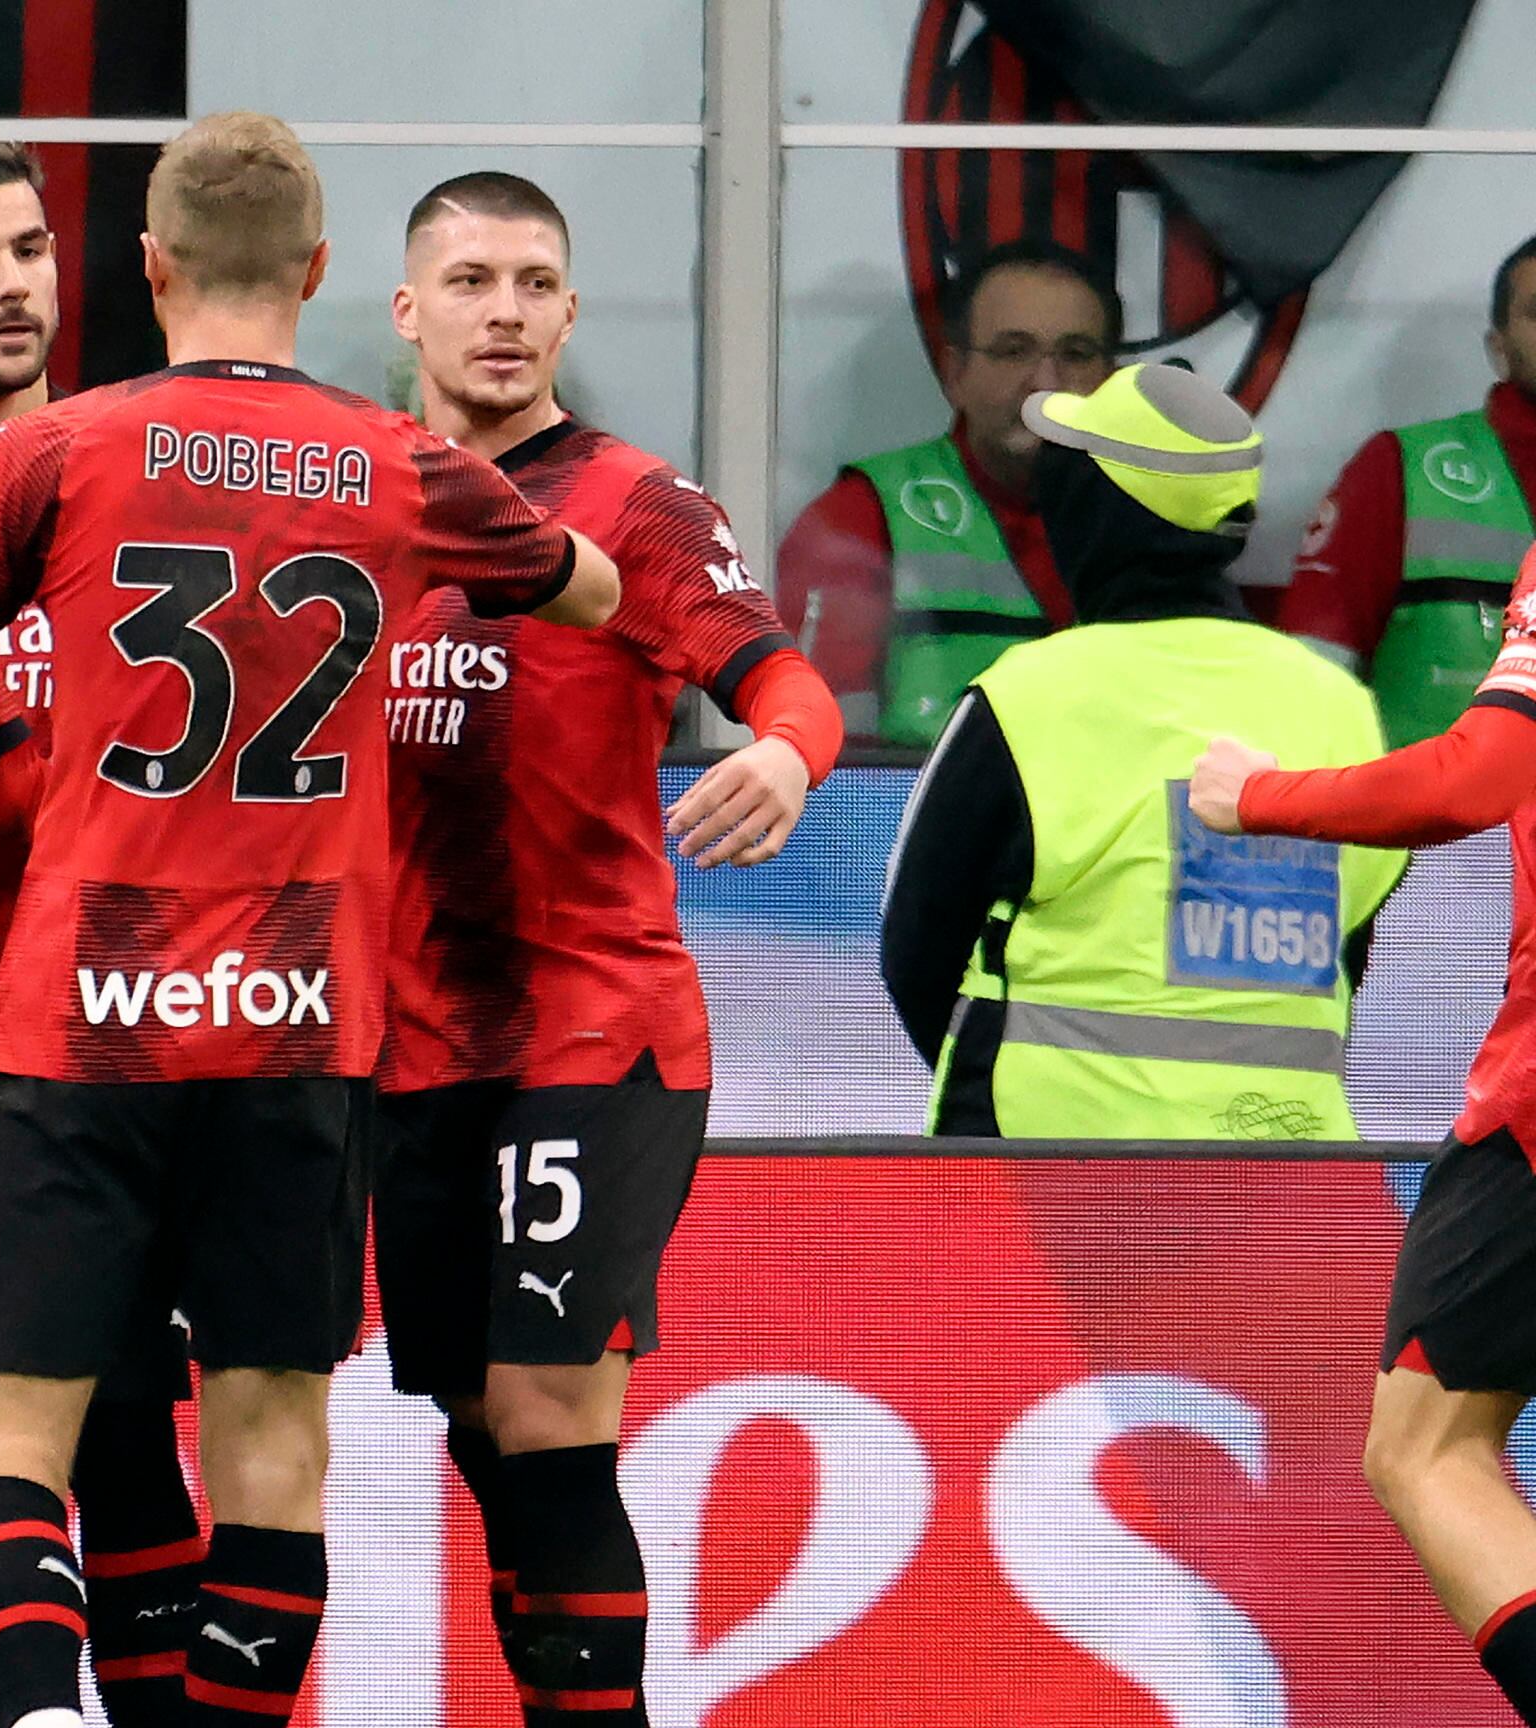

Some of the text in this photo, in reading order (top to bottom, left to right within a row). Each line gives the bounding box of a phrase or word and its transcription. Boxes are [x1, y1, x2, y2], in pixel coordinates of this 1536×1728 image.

[144, 422, 372, 506] POBEGA
[97, 542, 384, 803] 32
[390, 633, 509, 691] rates
[1182, 900, 1332, 969] W1658
[76, 951, 332, 1029] wefox
[497, 1138, 582, 1244] 15
